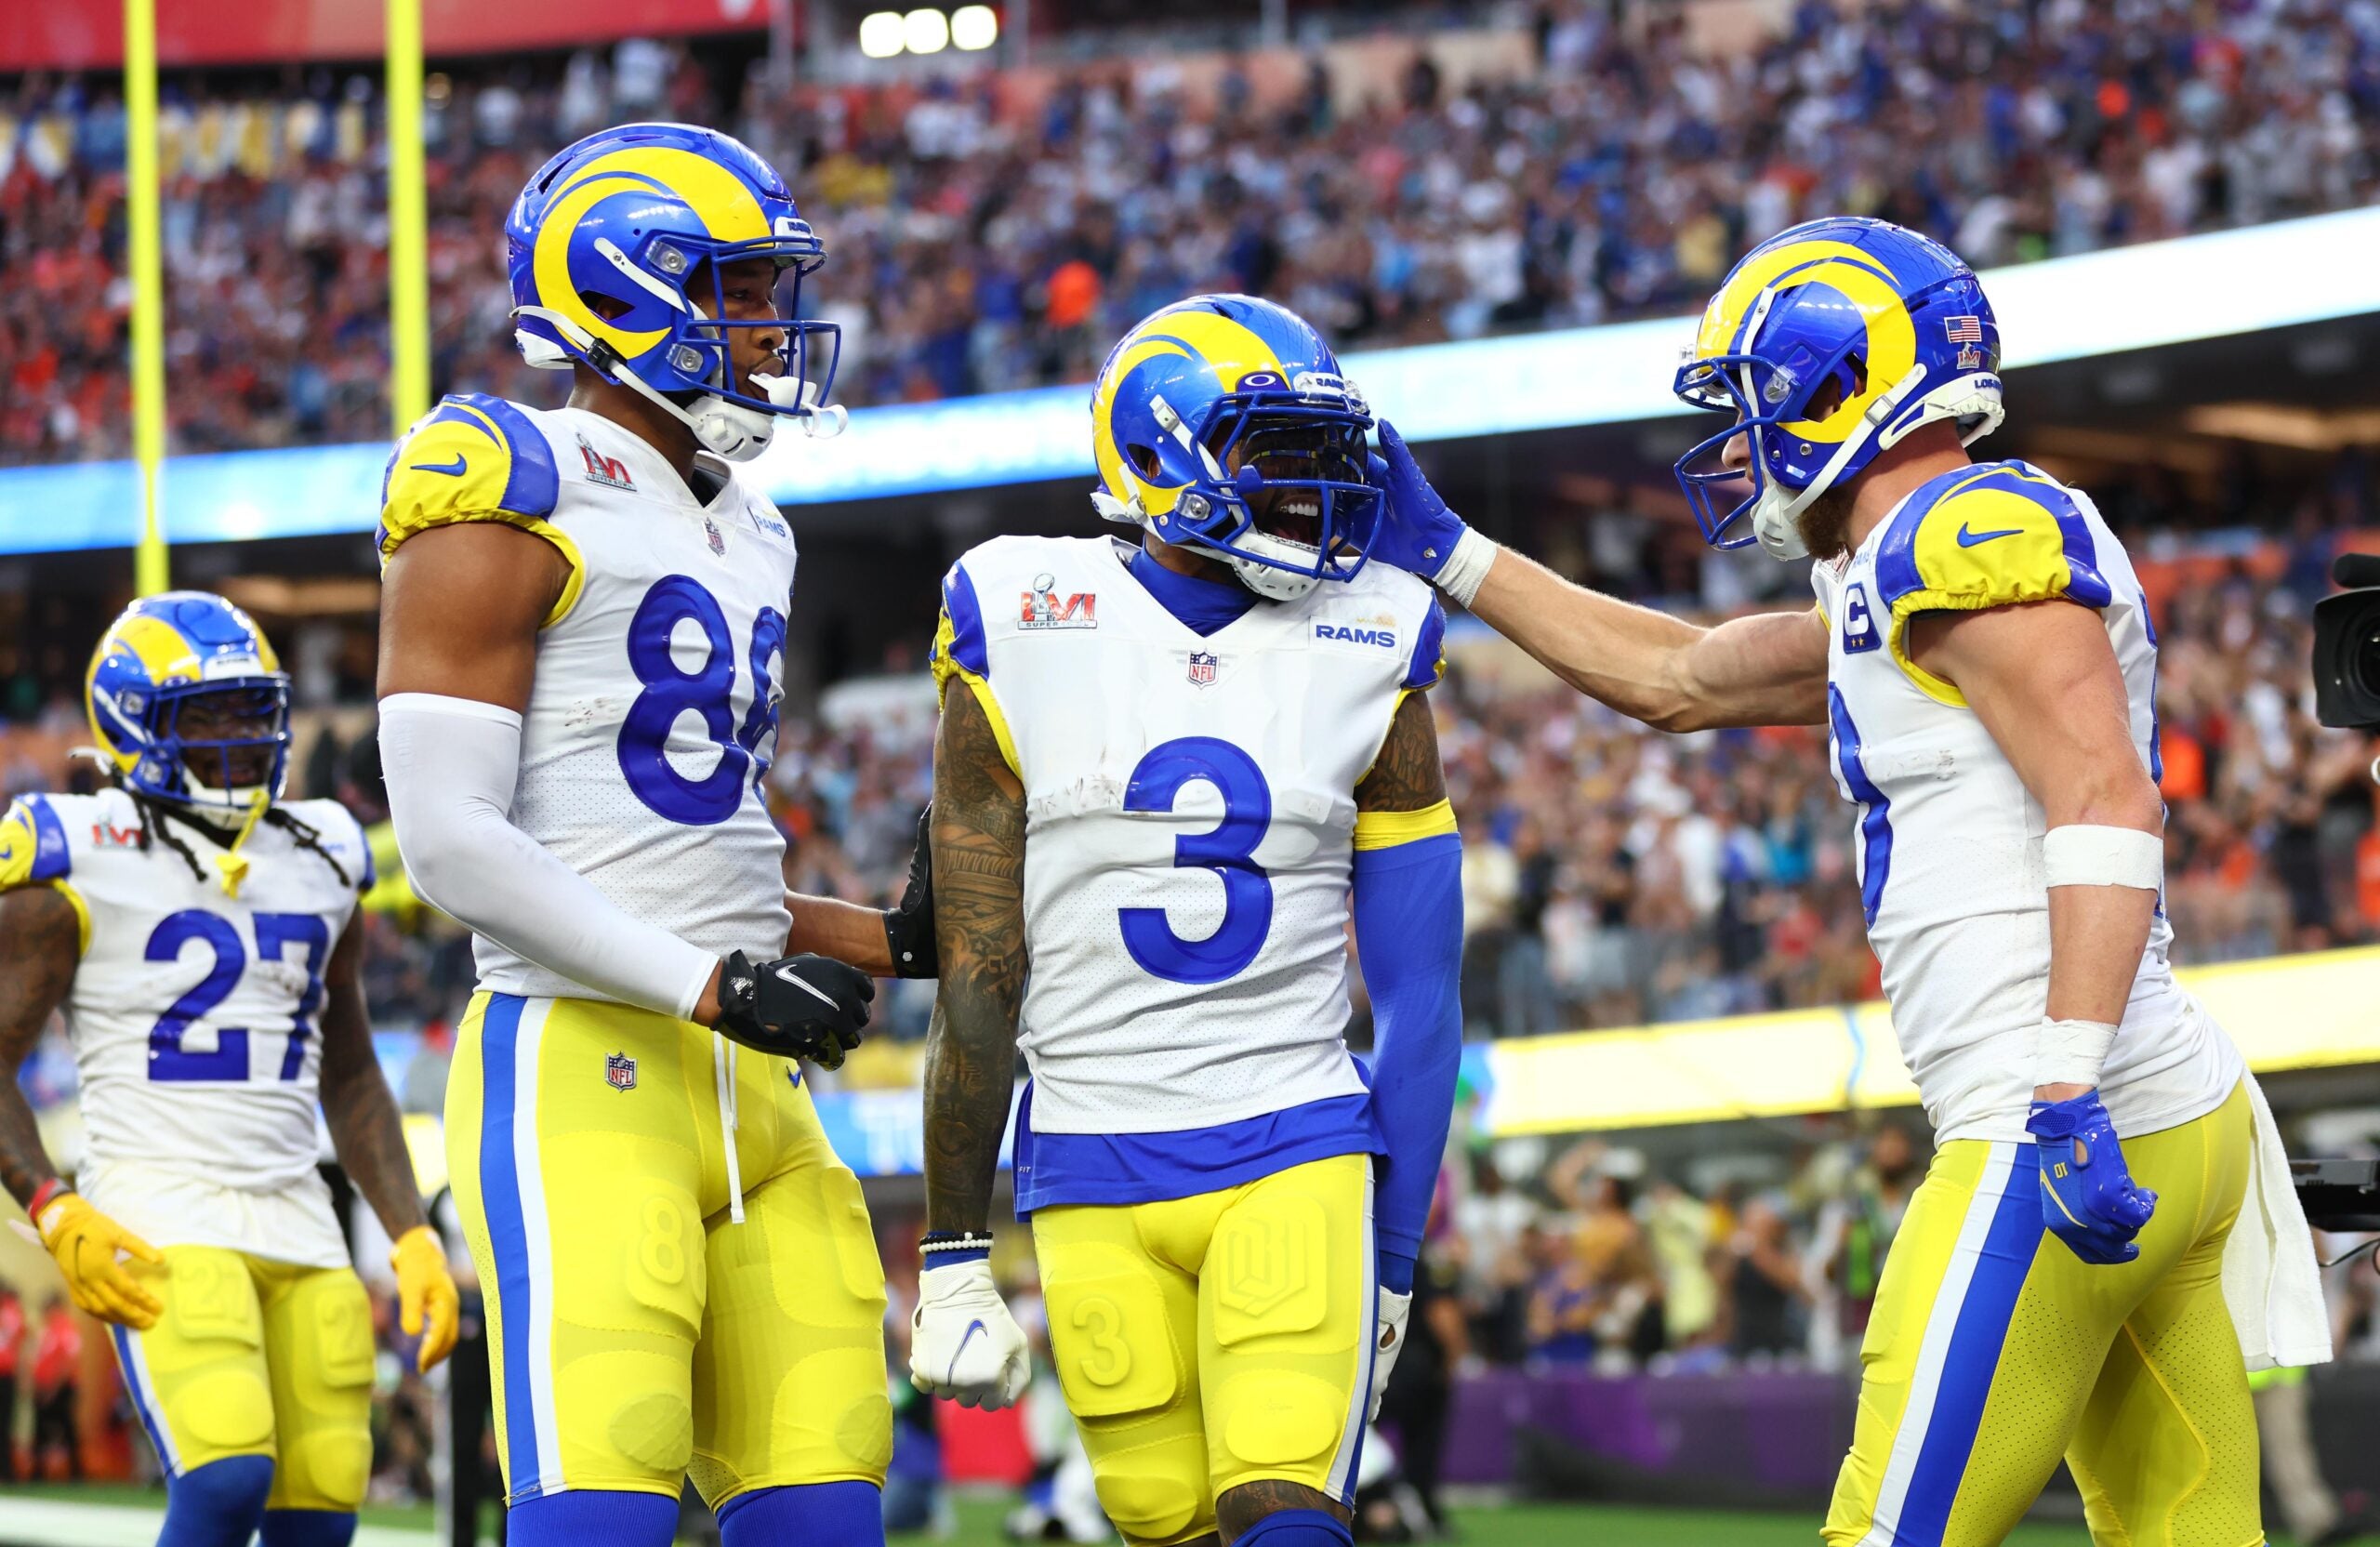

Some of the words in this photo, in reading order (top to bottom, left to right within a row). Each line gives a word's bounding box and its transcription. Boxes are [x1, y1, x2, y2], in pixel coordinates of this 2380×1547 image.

[755, 515, 786, 538] RAMS
[1844, 588, 1869, 636] C
[1316, 624, 1396, 648] RAMS
[1191, 665, 1213, 681] NFL
[1118, 735, 1274, 985] 3
[144, 908, 330, 1081] 27
[611, 1067, 632, 1085] NFL
[1073, 1297, 1130, 1386] 3
